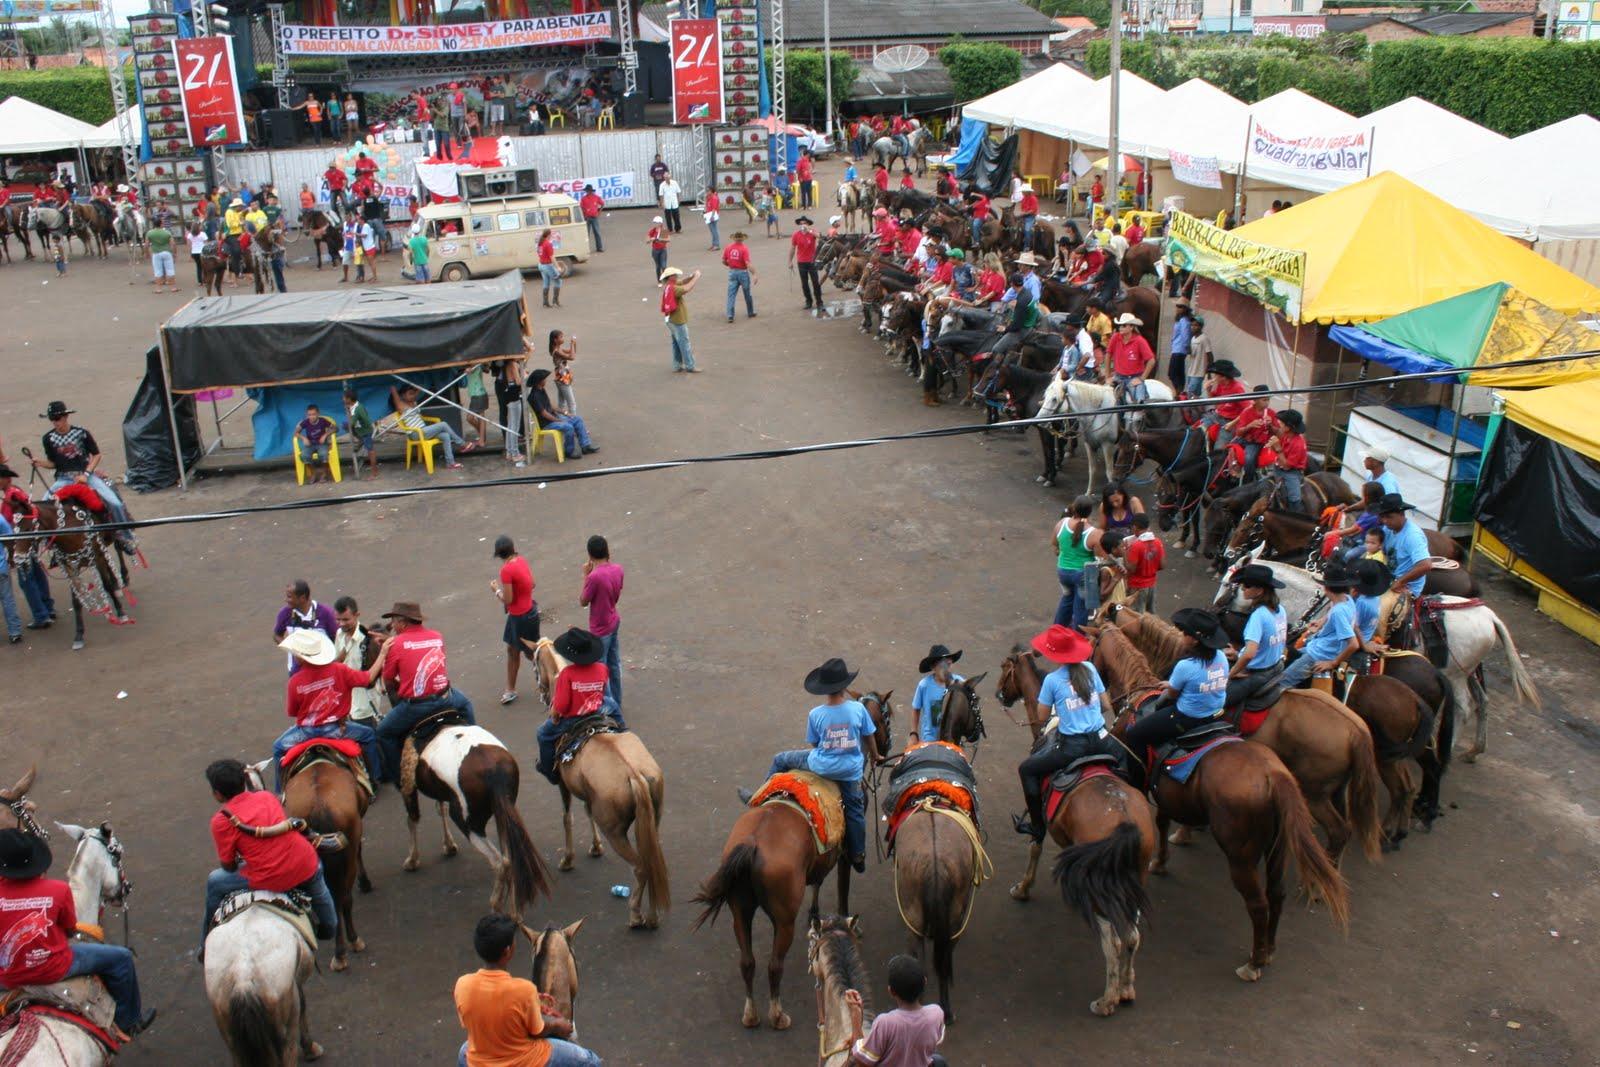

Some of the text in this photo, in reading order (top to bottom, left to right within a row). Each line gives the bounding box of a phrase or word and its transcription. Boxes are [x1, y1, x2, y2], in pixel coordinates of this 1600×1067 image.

[283, 28, 293, 39] O
[299, 28, 380, 40] PREFEITO
[503, 12, 607, 34] PARABENIZA
[442, 38, 457, 50] NO
[675, 33, 714, 69] 21
[184, 51, 223, 90] 21
[1255, 137, 1368, 170] Quadrangular
[598, 175, 622, 189] DE
